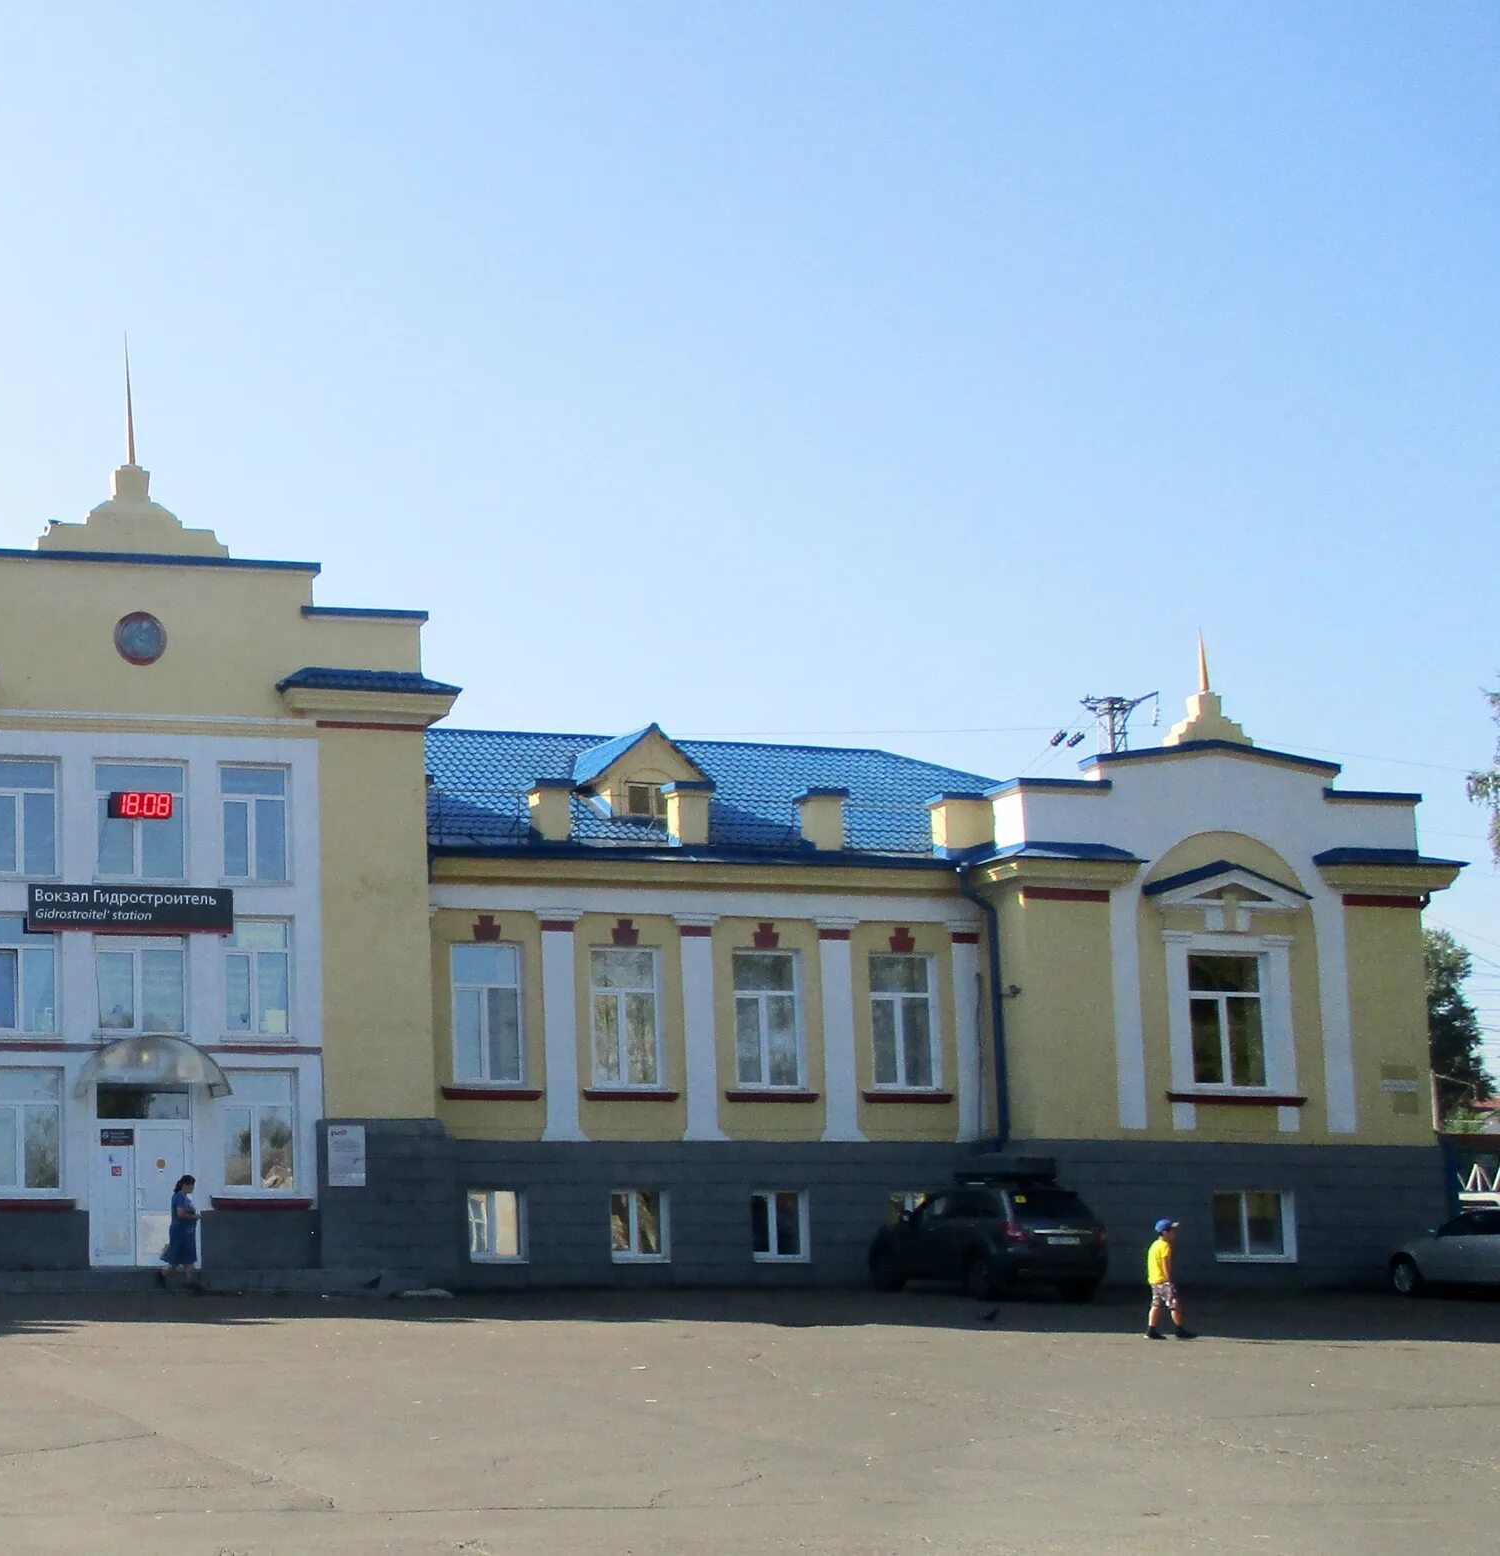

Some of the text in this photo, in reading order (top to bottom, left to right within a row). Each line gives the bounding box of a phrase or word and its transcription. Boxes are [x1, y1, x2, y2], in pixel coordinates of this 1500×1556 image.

[121, 793, 171, 816] 18.08
[35, 889, 217, 907] Вокзал Гидростроитель
[35, 908, 152, 921] Gidrostroitel' station
